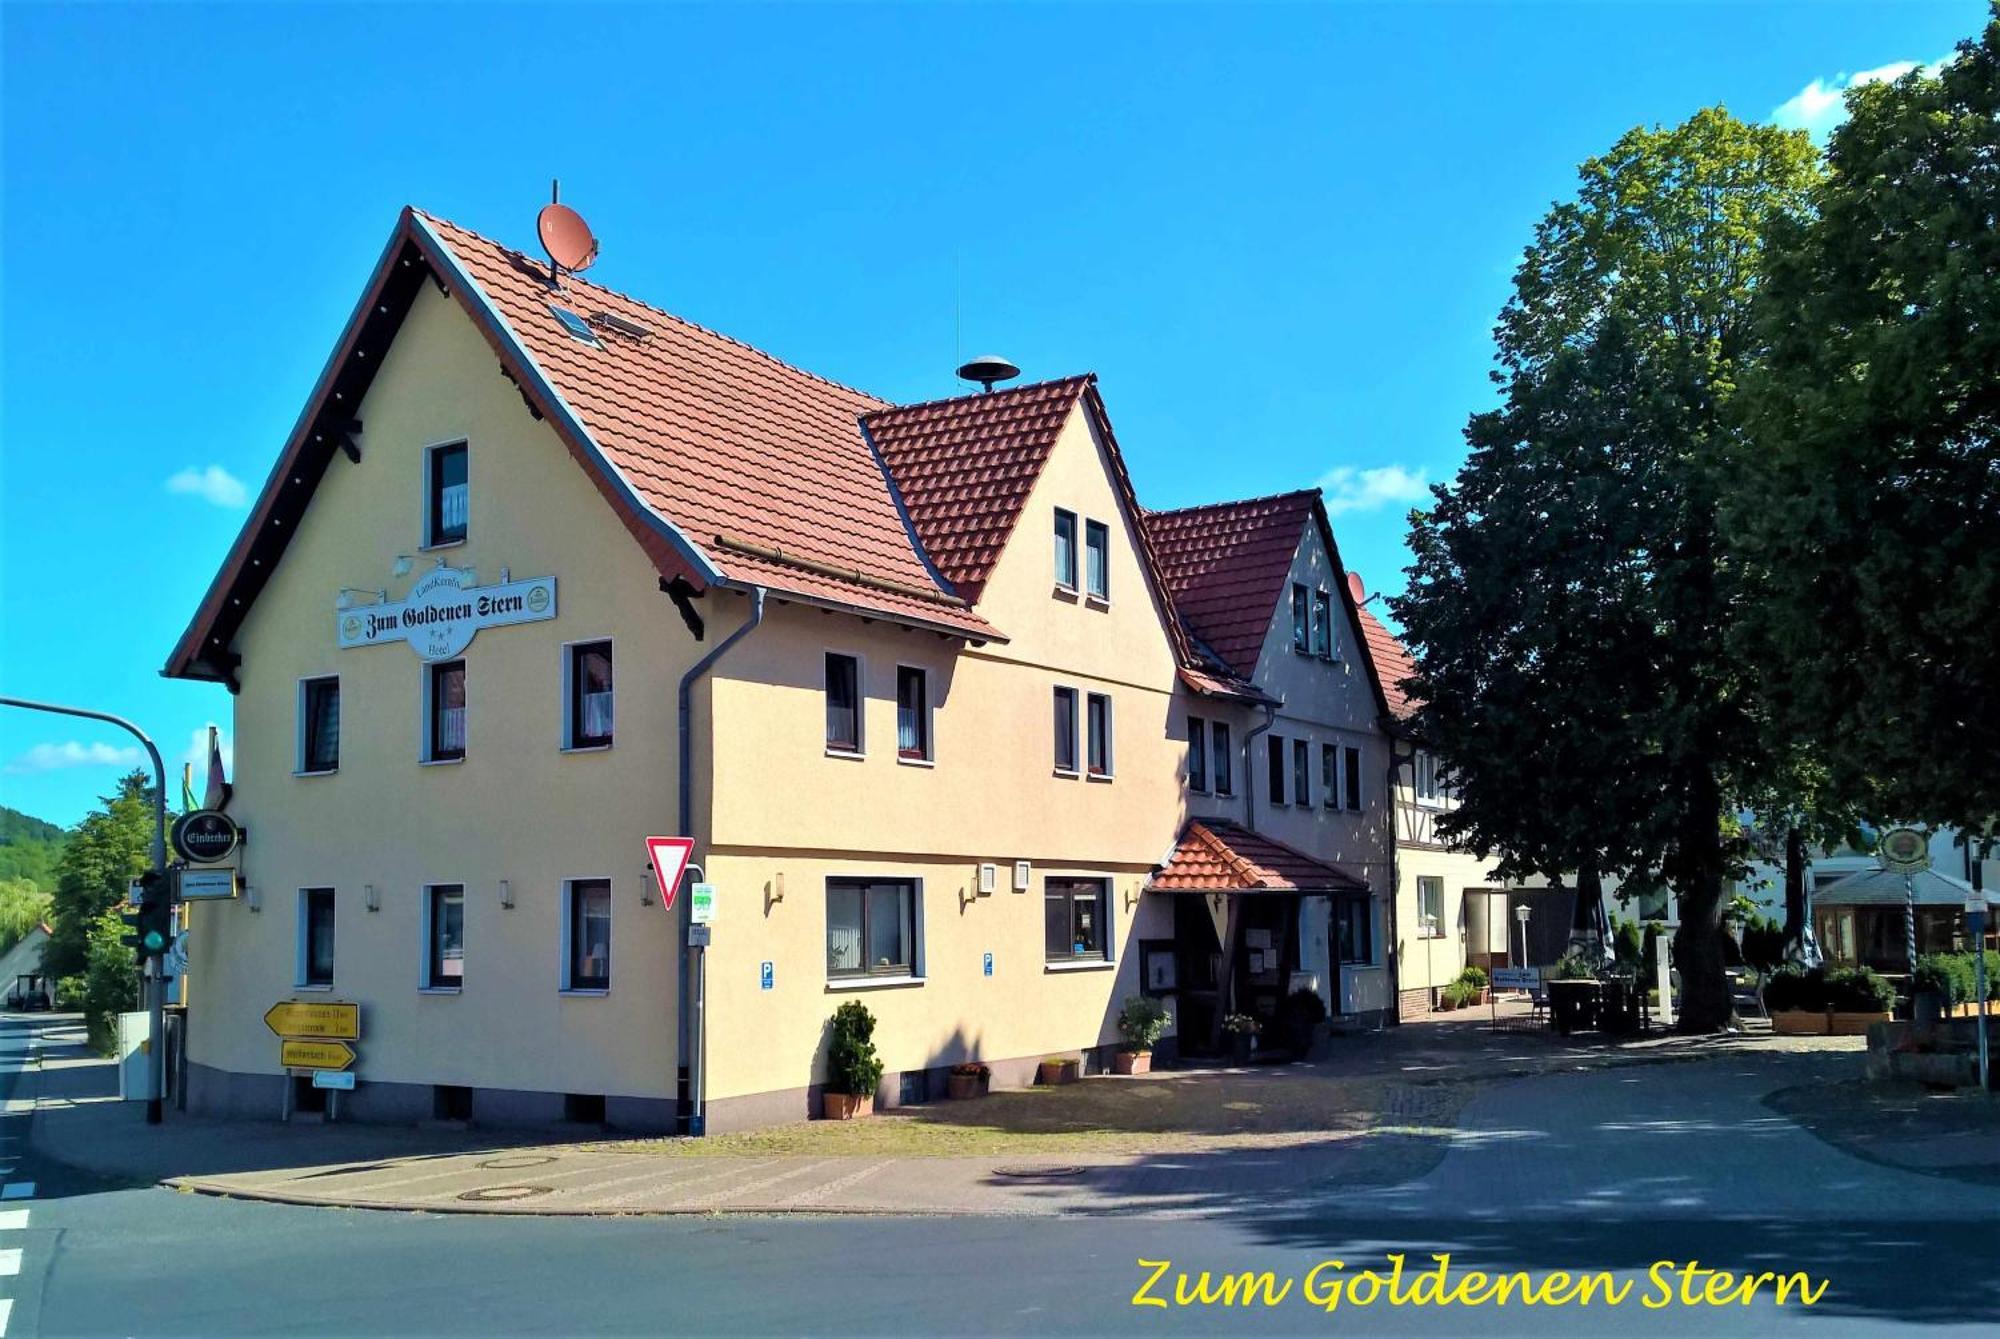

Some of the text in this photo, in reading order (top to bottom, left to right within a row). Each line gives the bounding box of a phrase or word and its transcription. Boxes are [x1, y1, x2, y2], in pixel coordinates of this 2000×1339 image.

[366, 613, 398, 639] Zum
[402, 603, 472, 628] Goldenen
[477, 594, 523, 617] Stern
[764, 963, 771, 978] P
